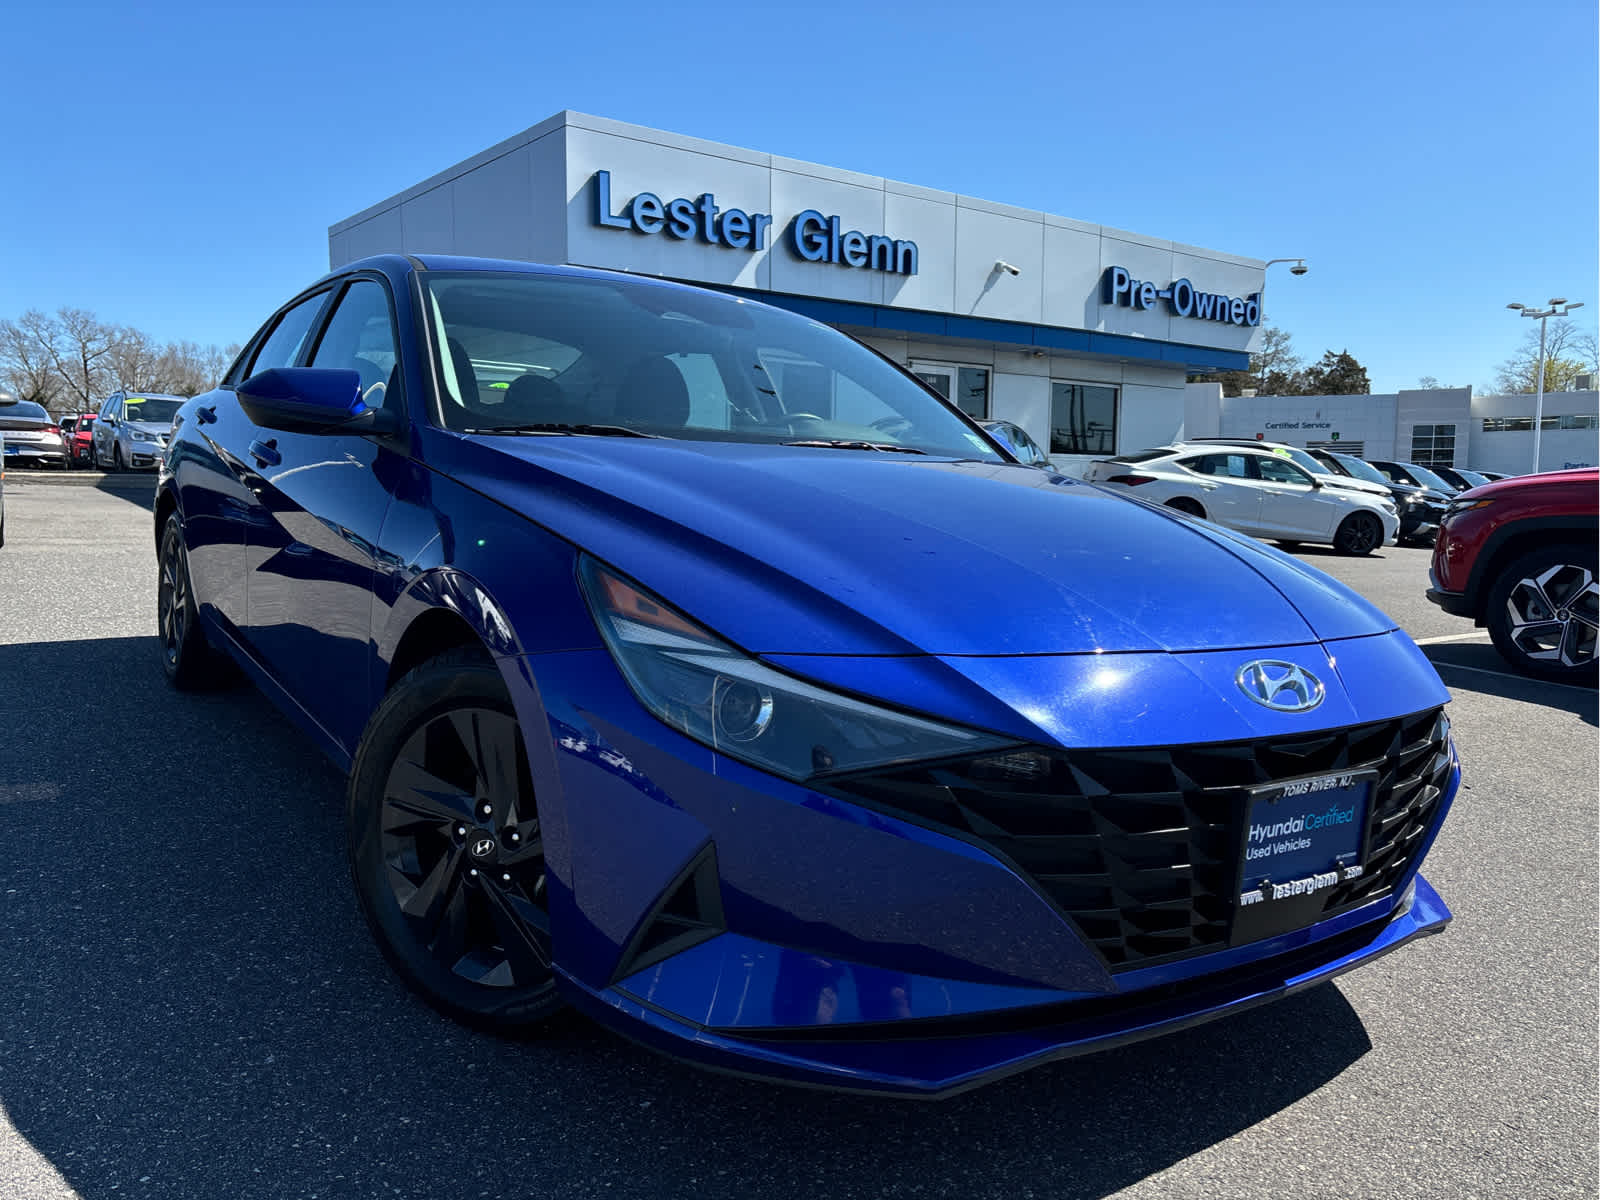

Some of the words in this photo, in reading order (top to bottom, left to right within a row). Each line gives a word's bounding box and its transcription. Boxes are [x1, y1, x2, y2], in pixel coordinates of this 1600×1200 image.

[594, 169, 772, 250] Lester
[792, 209, 918, 275] Glenn
[1104, 266, 1262, 327] Pre-Owned
[1265, 422, 1300, 430] Certified
[1301, 422, 1331, 430] Service
[1283, 783, 1309, 797] TOMS
[1248, 815, 1305, 842] Hyundai
[1305, 805, 1354, 830] Certified
[1246, 844, 1271, 860] Used
[1273, 838, 1311, 854] Vehicles
